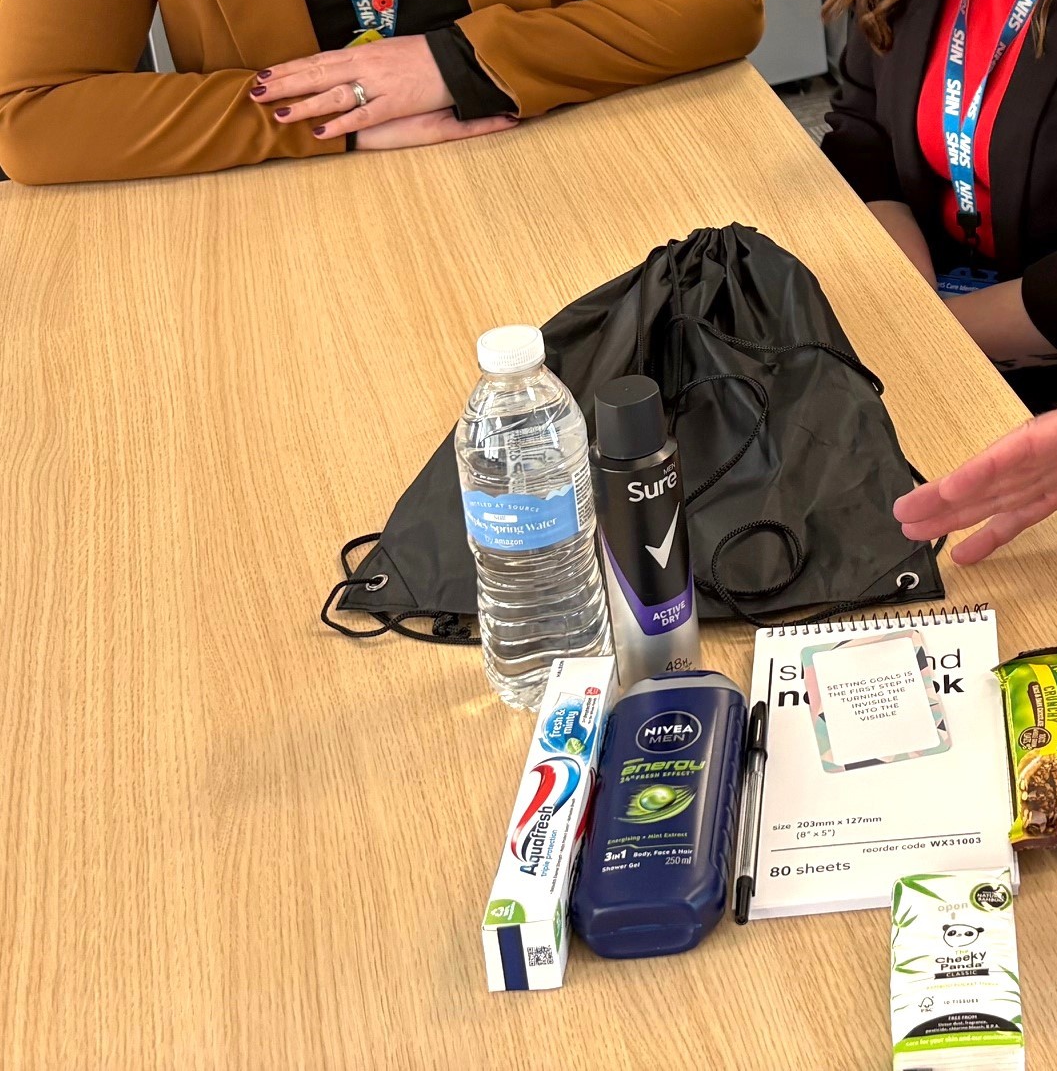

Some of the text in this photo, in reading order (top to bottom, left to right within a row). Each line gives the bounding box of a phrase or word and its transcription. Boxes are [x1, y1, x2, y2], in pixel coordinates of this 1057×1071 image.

[357, 0, 377, 26] NHS
[945, 29, 965, 165] NHS NHS NHS
[959, 133, 972, 168] NHS
[960, 180, 974, 213] NHS
[663, 462, 676, 474] MEN
[627, 470, 677, 503] Sure
[508, 504, 540, 513] SOURCE
[490, 517, 558, 535] Spring Water
[494, 538, 523, 546] amazon
[653, 600, 686, 620] ACTIVE
[661, 613, 680, 627] DRY
[827, 680, 867, 691] SETTING
[869, 673, 902, 684] GOALS
[828, 690, 847, 698] THE
[850, 685, 875, 695] FIRST
[879, 681, 902, 690] STEP
[841, 687, 906, 703] TURNING THE
[851, 695, 899, 709] INVISIBLE
[854, 703, 900, 716] INTO THE
[859, 710, 897, 721] VISIBLE
[549, 715, 564, 738] fresh
[563, 711, 579, 734] minty
[644, 724, 694, 737] NIVEA
[649, 734, 686, 744] MEN
[772, 823, 791, 831] size
[796, 820, 835, 829] 203mm
[846, 815, 883, 825] 127mm
[520, 805, 554, 877] Aquafresh
[607, 835, 640, 845] Energising
[862, 837, 982, 853] reorder code WX31003
[541, 830, 558, 877] triple protection
[665, 856, 692, 865] 250 ml
[602, 863, 627, 873] Shower
[769, 861, 851, 878] 80 sheets
[935, 951, 986, 966] Cheeky
[940, 962, 984, 971] Panda
